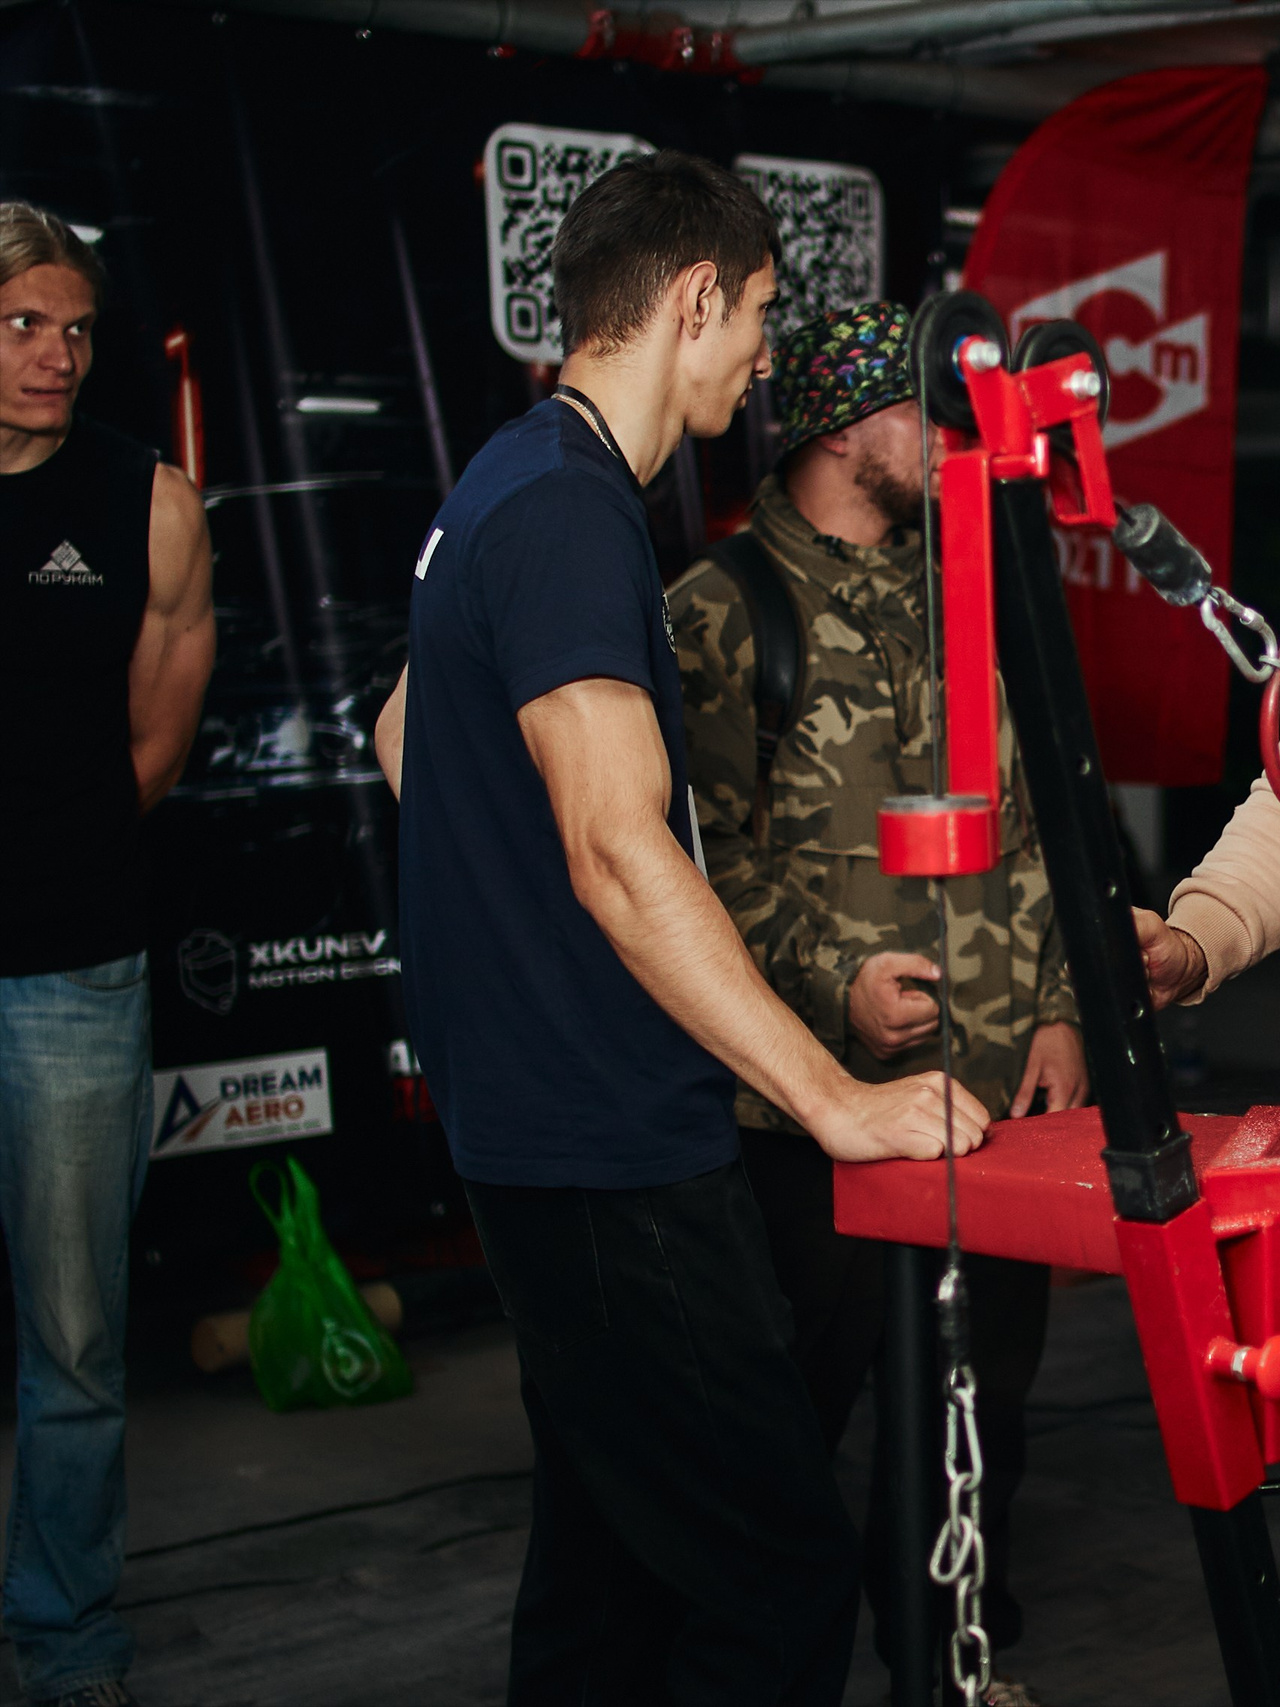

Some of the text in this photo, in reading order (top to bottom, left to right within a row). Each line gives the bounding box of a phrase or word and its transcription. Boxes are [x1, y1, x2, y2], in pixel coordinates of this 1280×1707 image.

[249, 964, 336, 990] MOTION
[220, 1068, 322, 1099] DREAM
[225, 1094, 305, 1130] AERO
